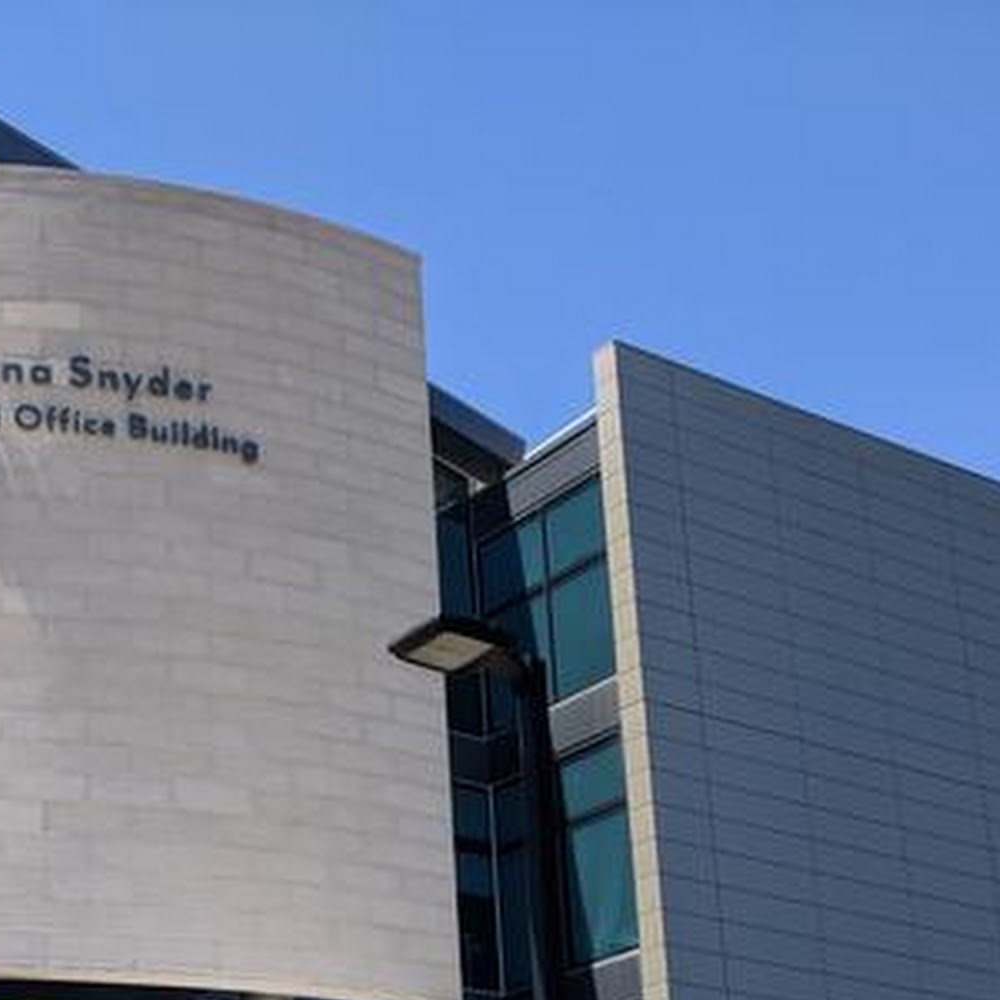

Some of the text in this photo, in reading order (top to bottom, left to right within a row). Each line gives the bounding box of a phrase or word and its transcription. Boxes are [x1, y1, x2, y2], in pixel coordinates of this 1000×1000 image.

[68, 354, 213, 401] Snyder
[14, 402, 116, 439] Office
[127, 411, 260, 465] Building
